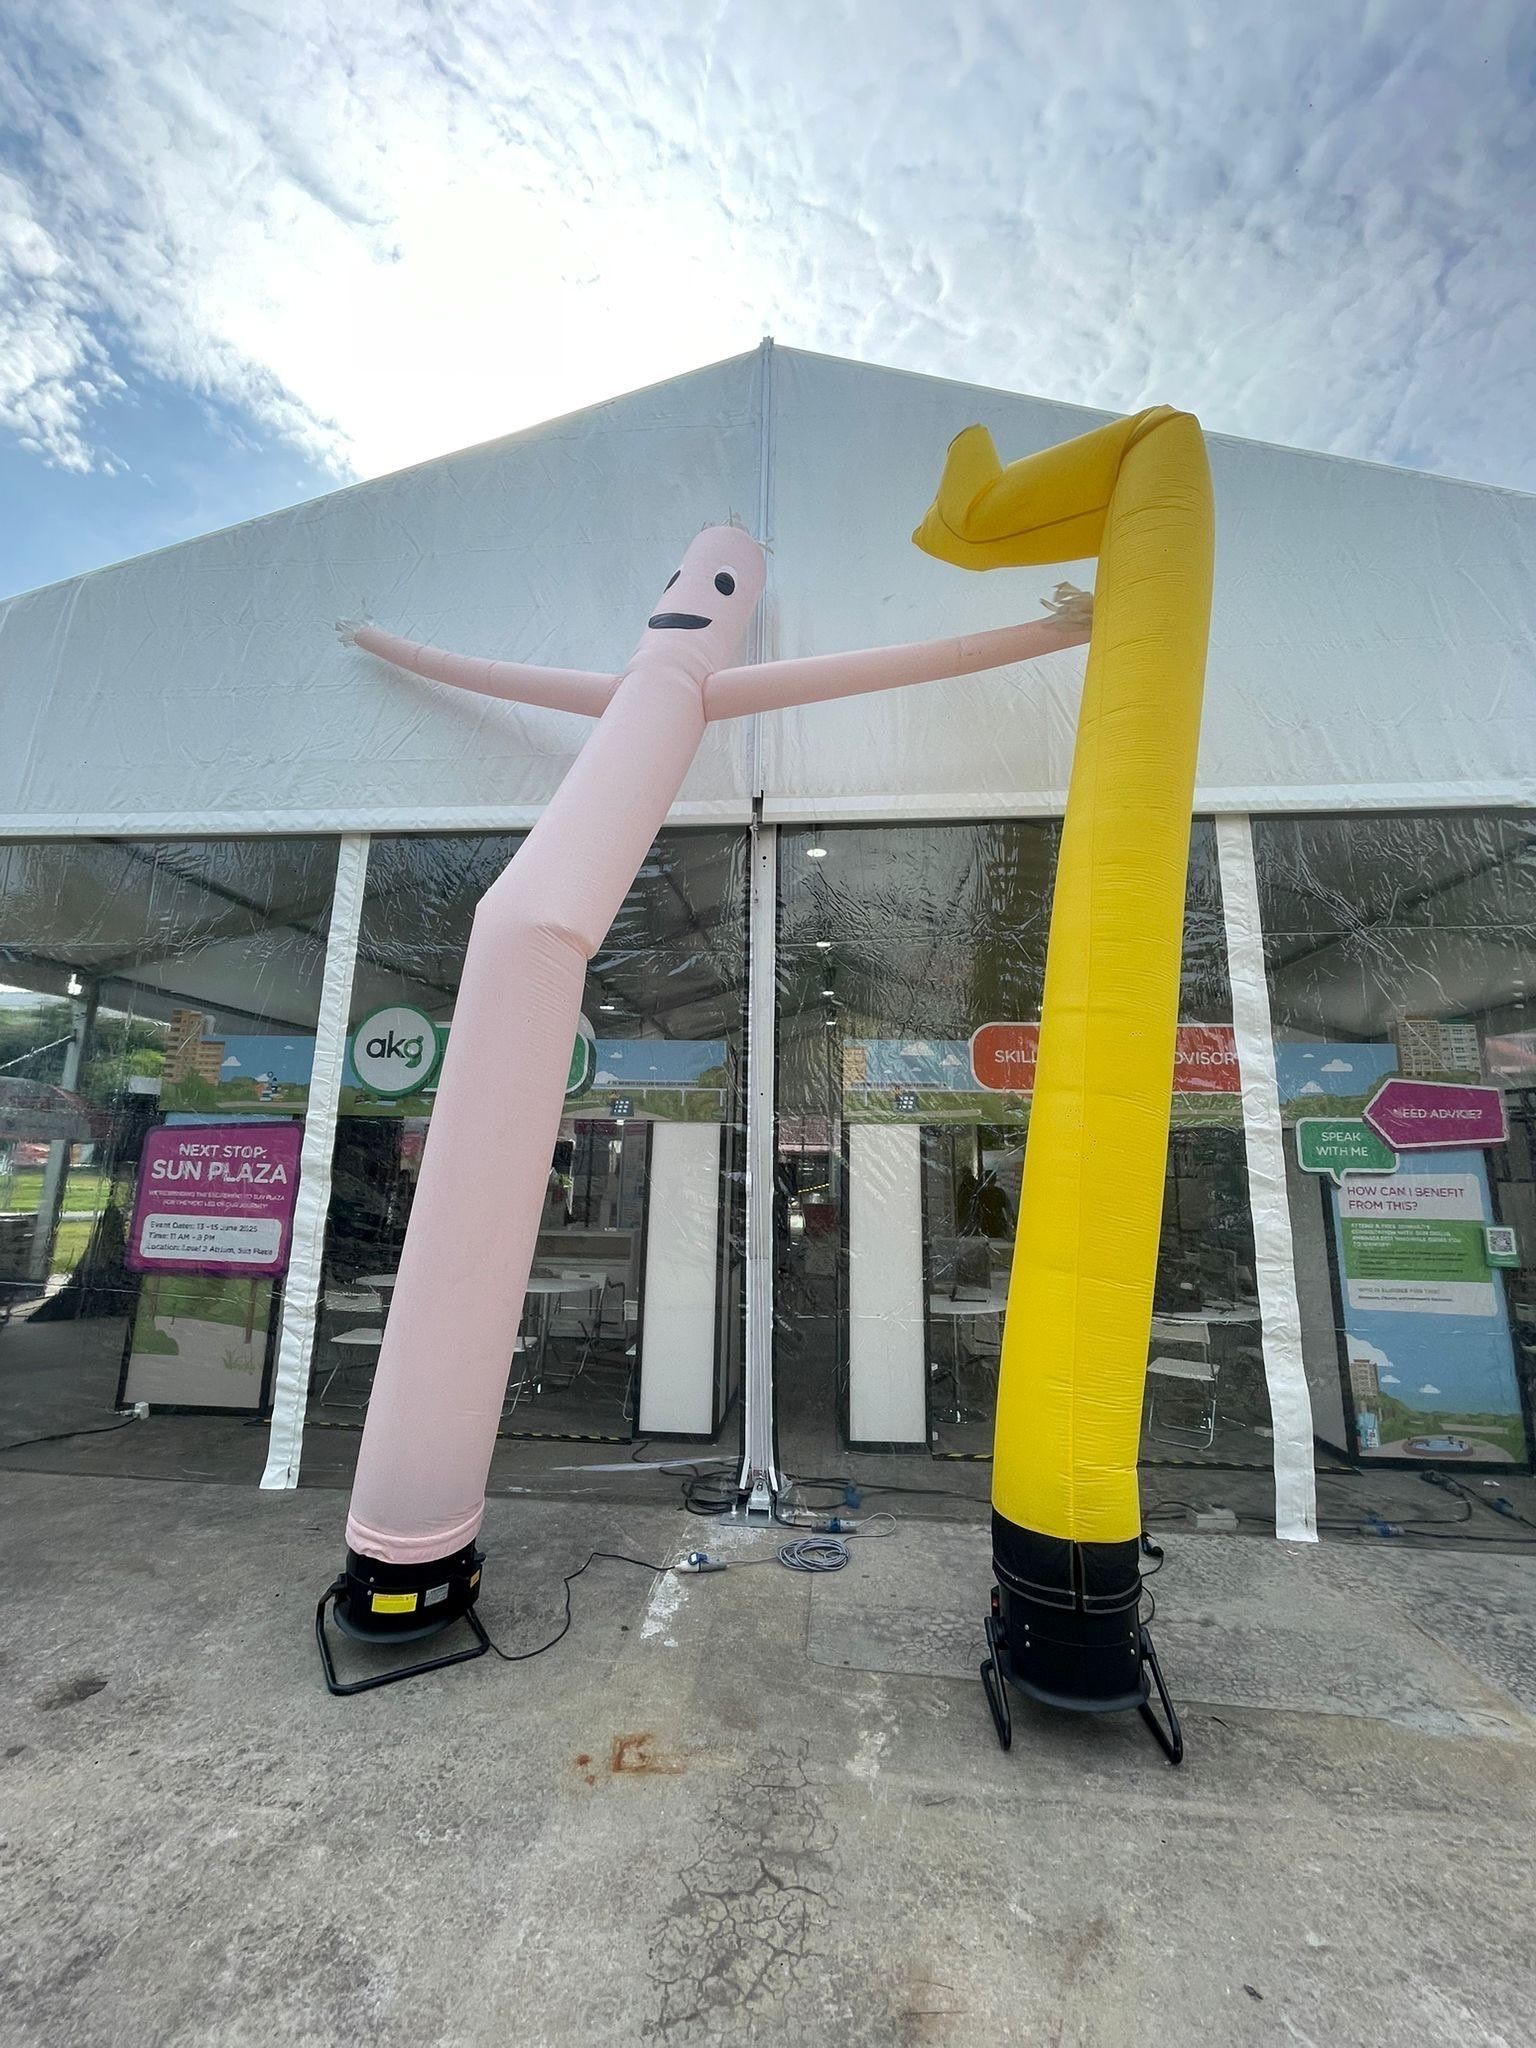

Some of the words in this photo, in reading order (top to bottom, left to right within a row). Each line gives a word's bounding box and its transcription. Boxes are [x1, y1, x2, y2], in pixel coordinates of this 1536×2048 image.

[366, 1030, 424, 1069] akg
[1174, 1051, 1238, 1065] DVISOR
[1393, 1108, 1427, 1119] NEED
[1430, 1108, 1483, 1119] ADVICE?
[1321, 1131, 1361, 1142] SPEAK
[179, 1143, 220, 1157] NEXT
[1315, 1145, 1348, 1156] WITH
[1351, 1146, 1369, 1157] ME
[151, 1158, 202, 1180] SUN
[207, 1161, 287, 1184] PLAZA
[1347, 1185, 1377, 1196] HOW
[1380, 1186, 1406, 1197] CAN
[1415, 1187, 1465, 1198] BENEFIT
[1348, 1200, 1383, 1211] FROM
[1385, 1201, 1418, 1212] THIS?
[150, 1220, 171, 1229] Event
